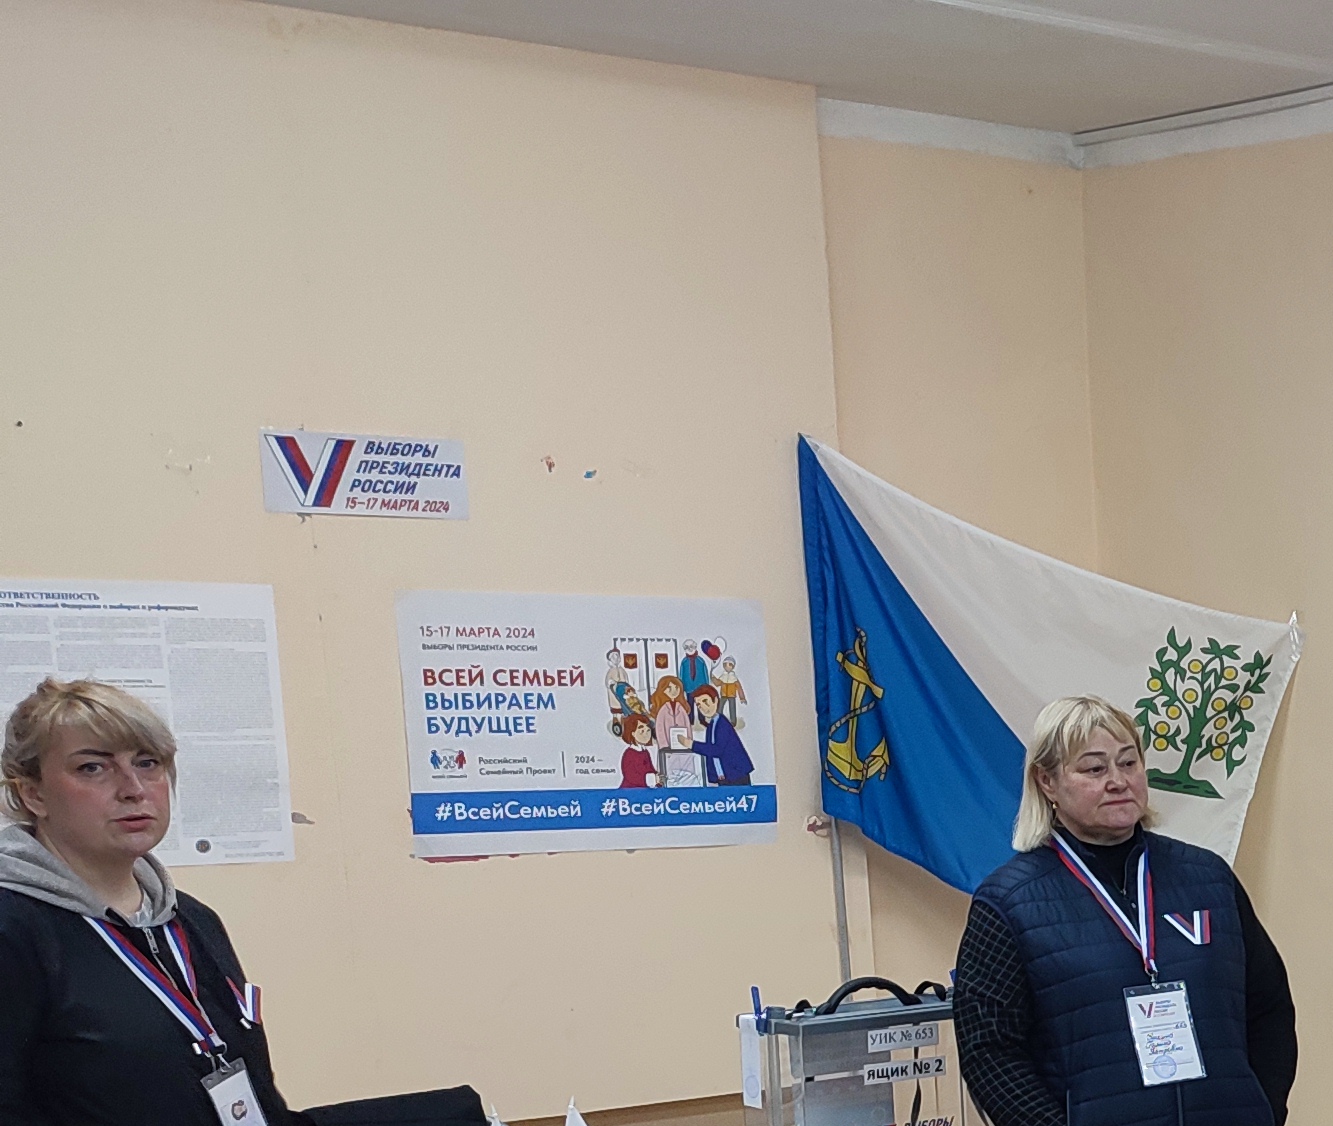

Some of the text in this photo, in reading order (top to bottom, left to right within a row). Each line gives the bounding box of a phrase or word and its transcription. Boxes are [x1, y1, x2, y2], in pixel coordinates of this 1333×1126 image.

[363, 440, 439, 459] ВЫБОРЫ
[356, 459, 462, 479] ПРЕЗИДЕНТА
[349, 478, 419, 496] РОССИИ
[379, 498, 420, 513] МАРТА
[421, 499, 451, 514] 2024
[0, 591, 100, 601] ОТВЕТСТВЕННОСТЬ
[455, 626, 502, 638] МАРТА
[506, 627, 536, 639] 2024
[421, 643, 538, 652] ВЫБОРЫ ПРЕЗИДЕНТА РОССИИ
[422, 664, 586, 687] ВСЕЙ СЕМЬЕЙ
[424, 692, 556, 711] ВЫБИРАЕМ
[427, 716, 537, 737] БУДУЩЕЕ
[478, 756, 528, 765] Российский
[574, 755, 596, 763] 2024
[526, 767, 556, 776] Проект
[435, 800, 582, 822] #ВсейСемьей
[601, 795, 758, 817] #ВсейСемьей47
[870, 1027, 933, 1045] УИК № 653
[913, 1061, 930, 1075] №
[935, 1059, 943, 1072] 2
